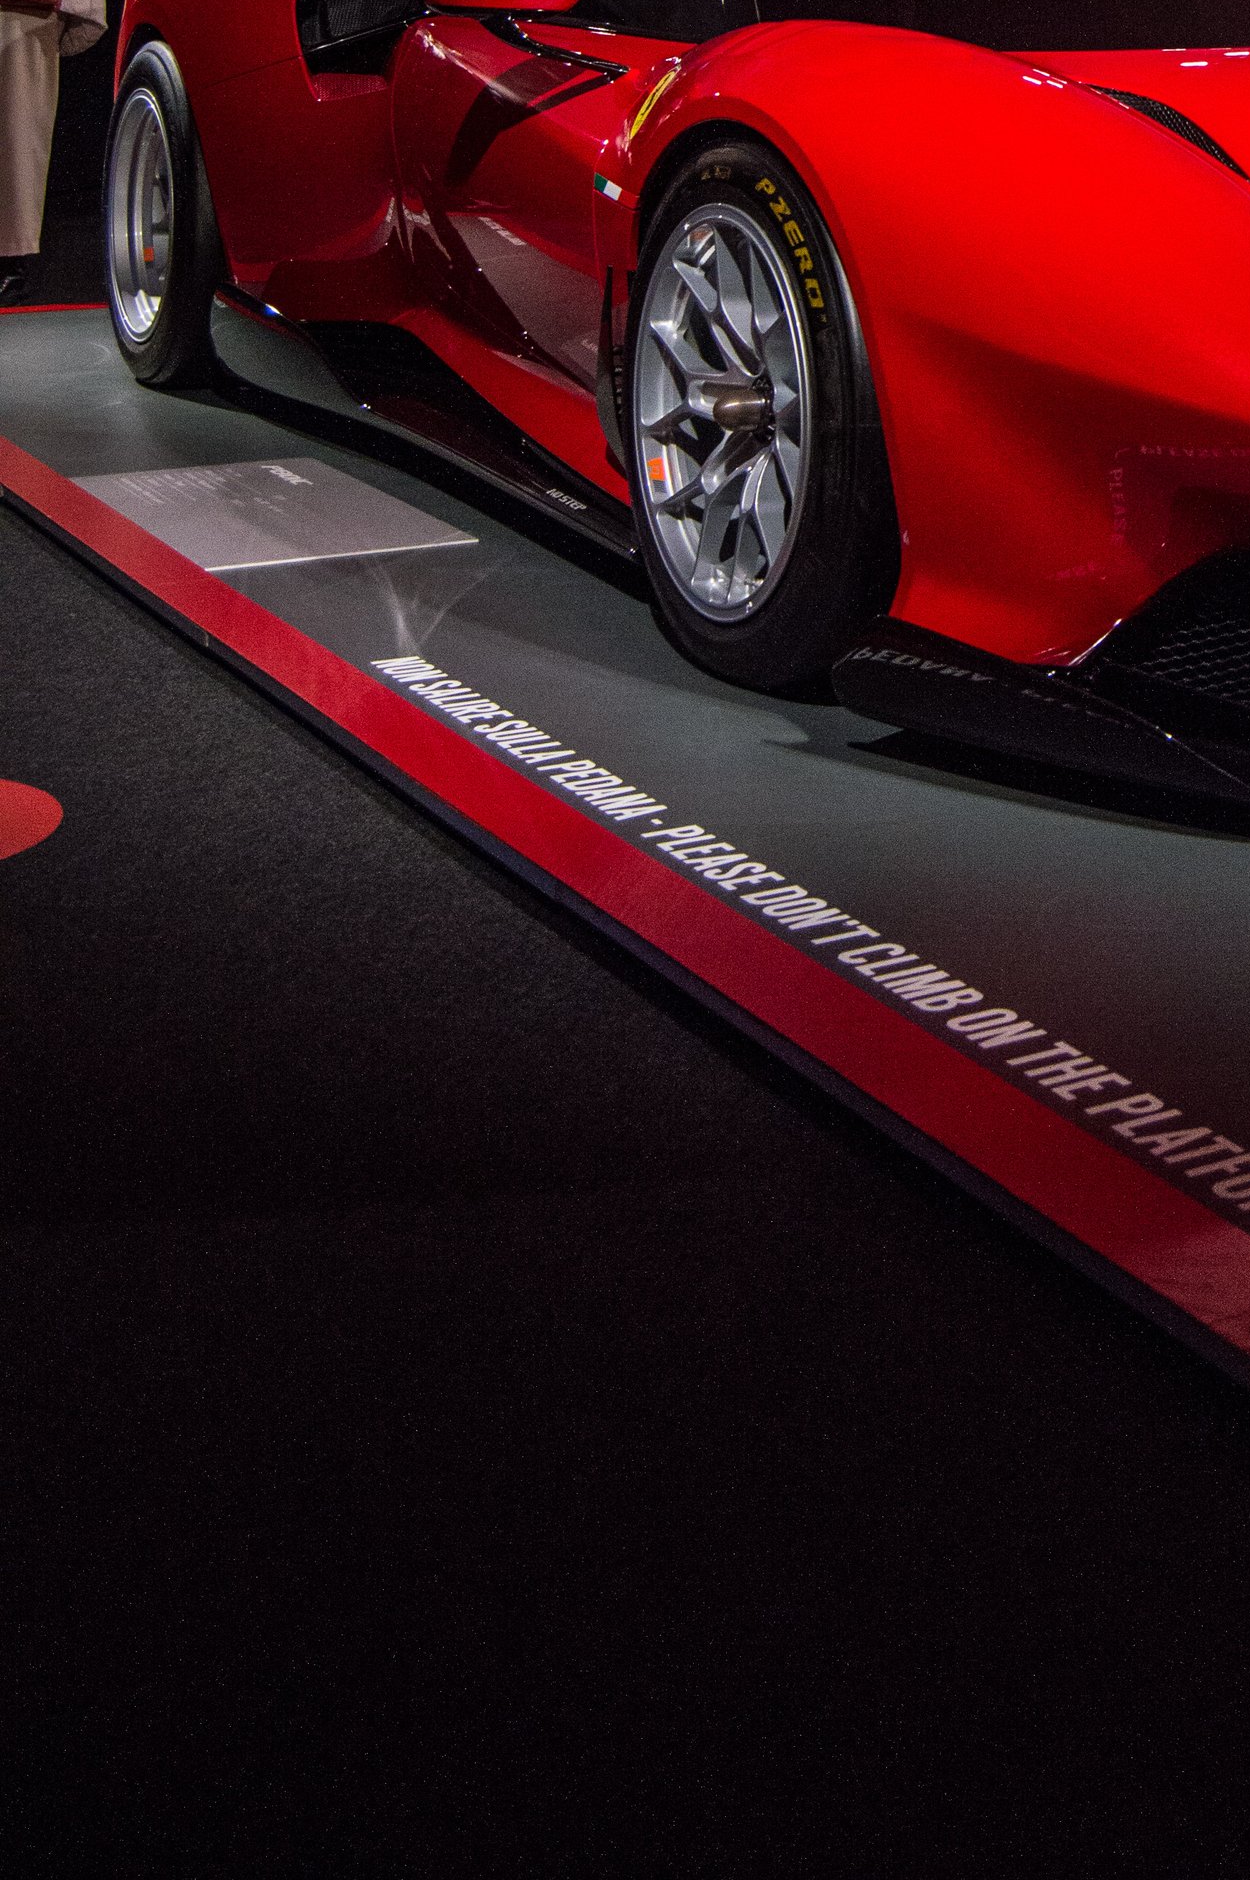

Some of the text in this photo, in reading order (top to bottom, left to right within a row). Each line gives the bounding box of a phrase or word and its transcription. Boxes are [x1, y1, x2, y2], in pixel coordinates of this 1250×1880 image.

[545, 488, 588, 511] NO STEP
[370, 656, 449, 683] NON
[408, 680, 514, 724] SALIRE
[473, 719, 576, 765] SULLA
[536, 759, 668, 822] PEDANA
[640, 824, 786, 891] PLEASE
[739, 884, 882, 946] DON'T
[837, 942, 984, 1012] CLIMB
[945, 1007, 1048, 1050] ON
[1005, 1040, 1133, 1101] THE
